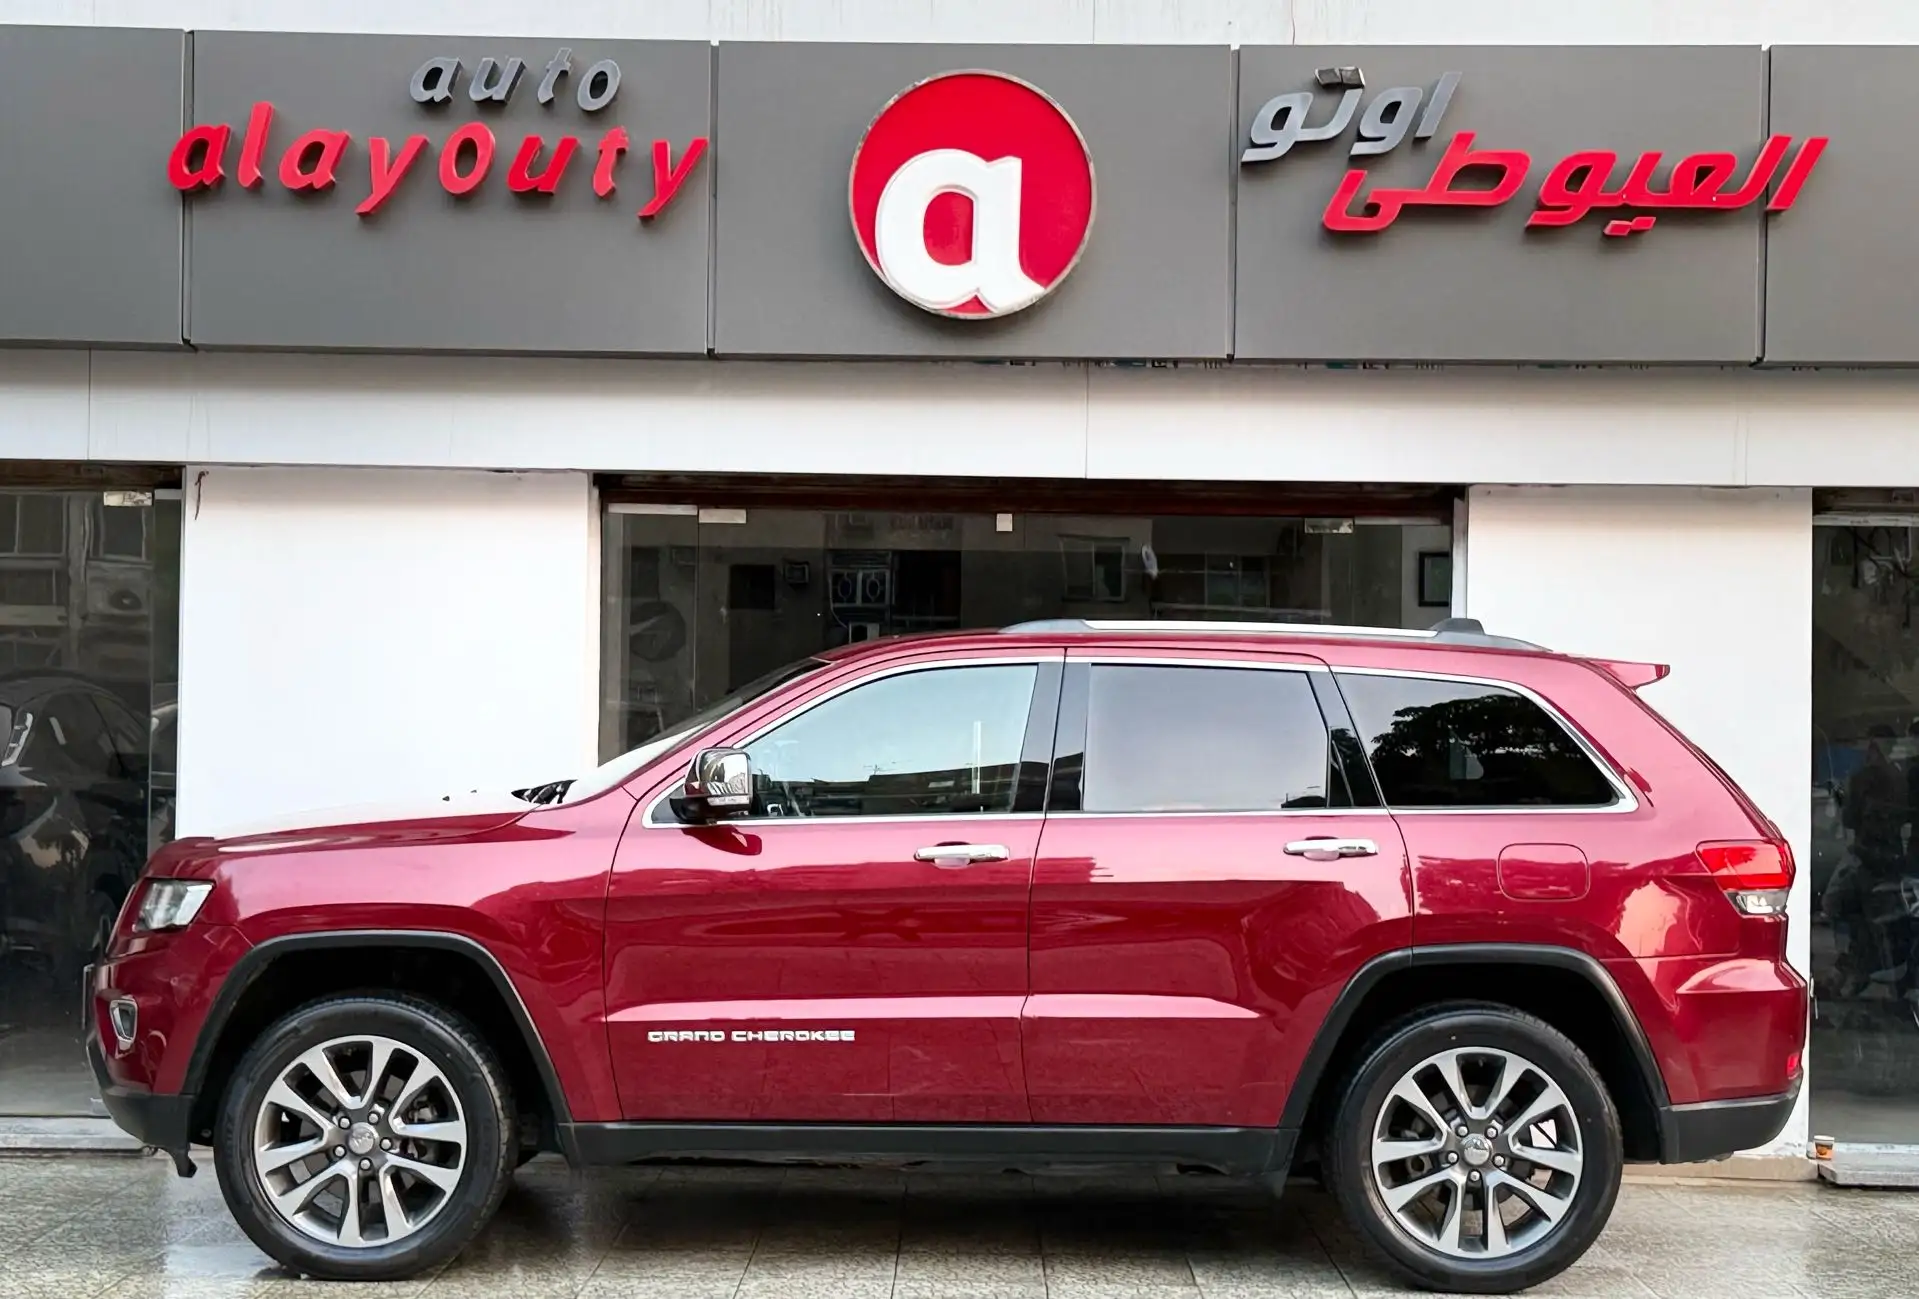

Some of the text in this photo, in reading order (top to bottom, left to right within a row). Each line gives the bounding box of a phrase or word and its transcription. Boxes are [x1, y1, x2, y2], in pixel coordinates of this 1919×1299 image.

[410, 48, 622, 111] auto
[1241, 66, 1463, 164] اوتو
[168, 102, 709, 218] alayouty
[874, 147, 1046, 314] a
[647, 1029, 856, 1042] GRAND CHEROKEE
